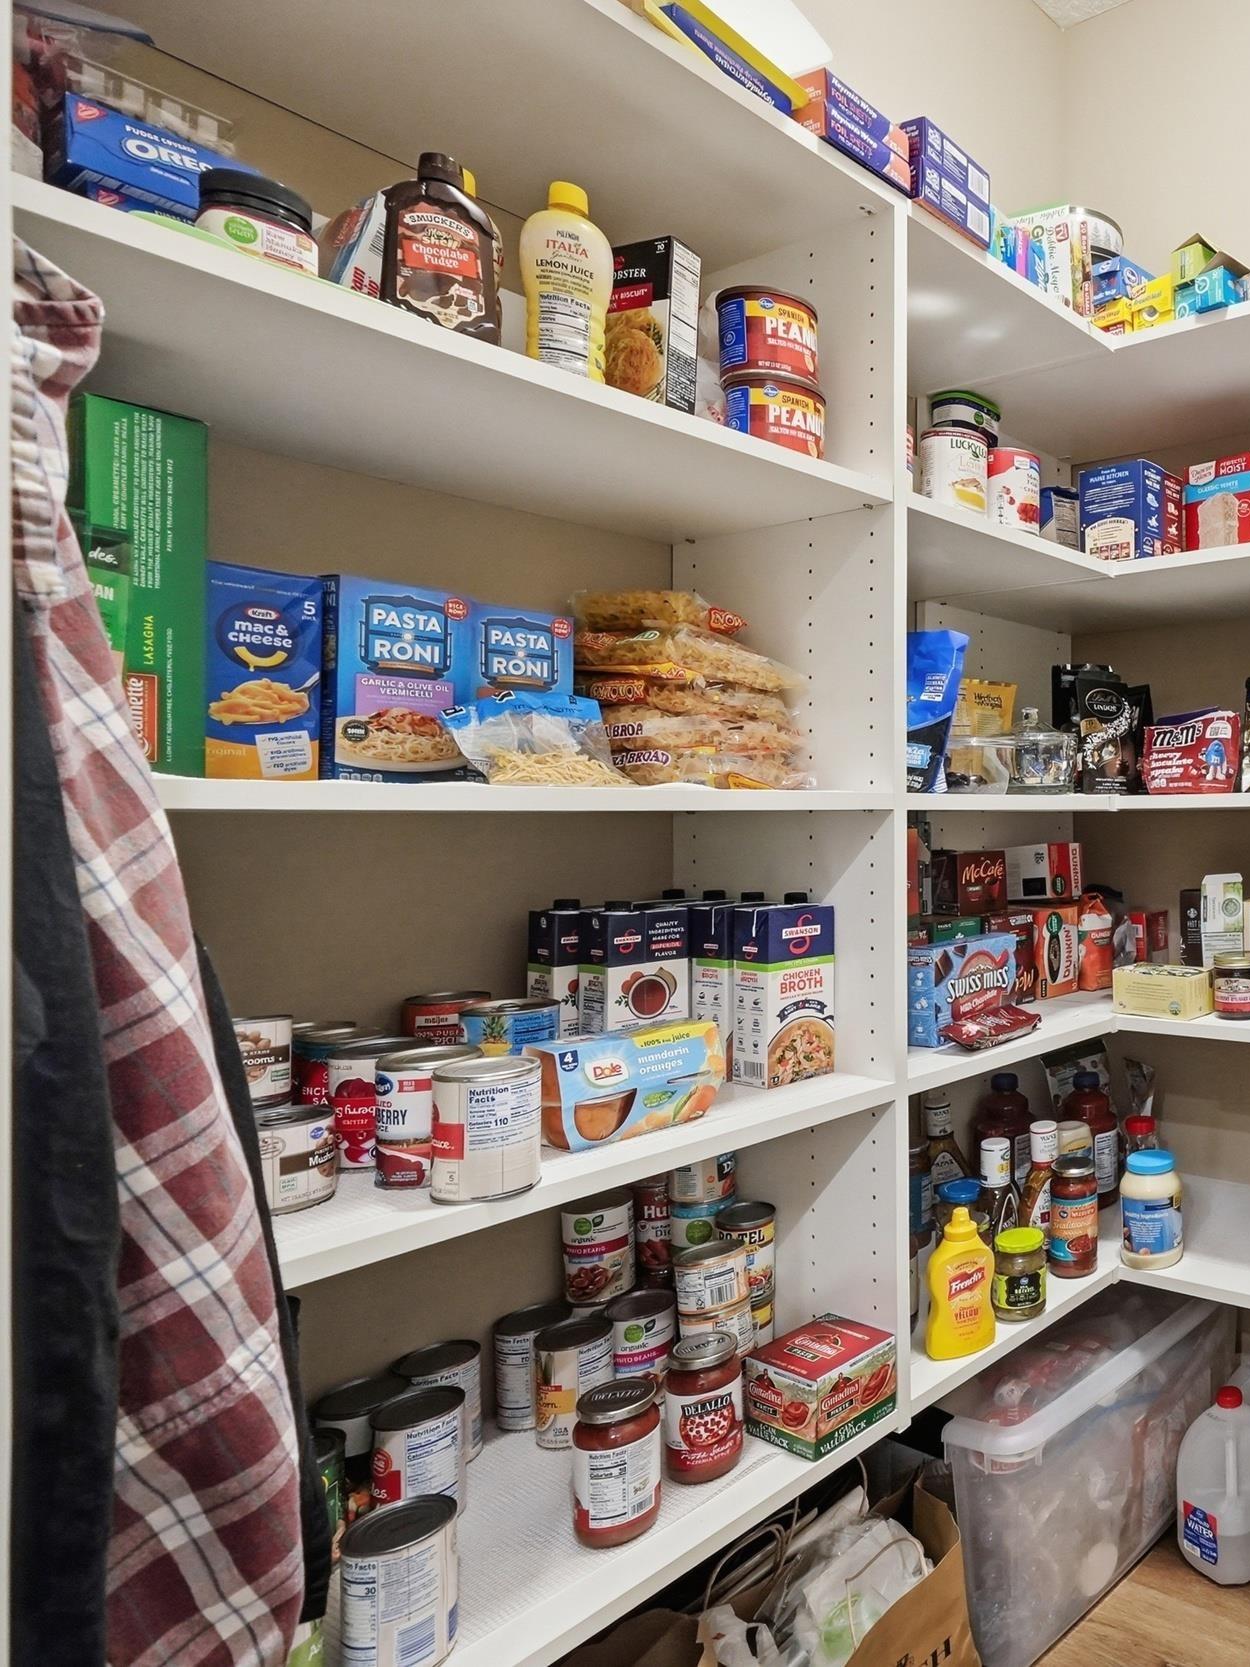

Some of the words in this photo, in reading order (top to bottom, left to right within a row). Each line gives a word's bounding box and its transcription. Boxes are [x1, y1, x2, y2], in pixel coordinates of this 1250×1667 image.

[411, 243, 470, 263] Chocolate
[545, 238, 589, 259] ITALIA
[423, 255, 461, 270] Fudge
[535, 258, 569, 271] LEMON
[569, 265, 595, 280] JUICE
[777, 301, 805, 324] SPANISH
[781, 393, 810, 410] SPANISH
[1219, 462, 1248, 476] MOIST
[1197, 483, 1220, 495] CLASSIC
[250, 609, 274, 619] Kraft
[302, 601, 316, 616] 5
[234, 620, 273, 634] mac
[276, 624, 290, 637] &
[371, 608, 442, 634] PASTA
[143, 614, 155, 666] LASAGNA
[490, 629, 549, 651] PASTA
[373, 639, 440, 664] RONI
[492, 657, 548, 678] RONI
[360, 677, 396, 688] GARLIC
[406, 682, 433, 691] OLIVE
[434, 684, 450, 693] OIL
[379, 687, 434, 699] VERMICELLI
[612, 722, 643, 737] BROA
[627, 750, 670, 765] BROAD
[961, 859, 1005, 884] McCafé
[784, 926, 820, 938] SWANSON
[782, 968, 821, 982] CHICKEN
[780, 977, 823, 994] BROTH
[946, 973, 982, 1003] SWISS
[983, 966, 1009, 990] MISS
[424, 1016, 449, 1025] meijer
[671, 1032, 691, 1044] juice
[564, 1052, 573, 1064] 4
[637, 1046, 690, 1064] mandarin
[593, 1063, 623, 1079] Dole
[639, 1058, 684, 1076] oranges
[468, 1086, 509, 1097] Nutrition
[468, 1095, 496, 1104] Facts
[376, 1109, 408, 1126] BERRY
[494, 1117, 509, 1127] 110
[570, 1235, 597, 1245] organic
[949, 1268, 985, 1297] French's
[953, 1306, 980, 1322] YELLOW
[620, 1342, 649, 1353] organic
[749, 1382, 783, 1406] Contadina
[821, 1381, 860, 1412] Contadina
[683, 1395, 732, 1417] DELALLO
[829, 1401, 852, 1418] PASTE
[406, 1423, 441, 1440] Nutrition
[819, 1434, 846, 1454] VALUE
[846, 1419, 868, 1438] PACK
[1187, 1517, 1214, 1540] WATER
[364, 1587, 377, 1595] 30
